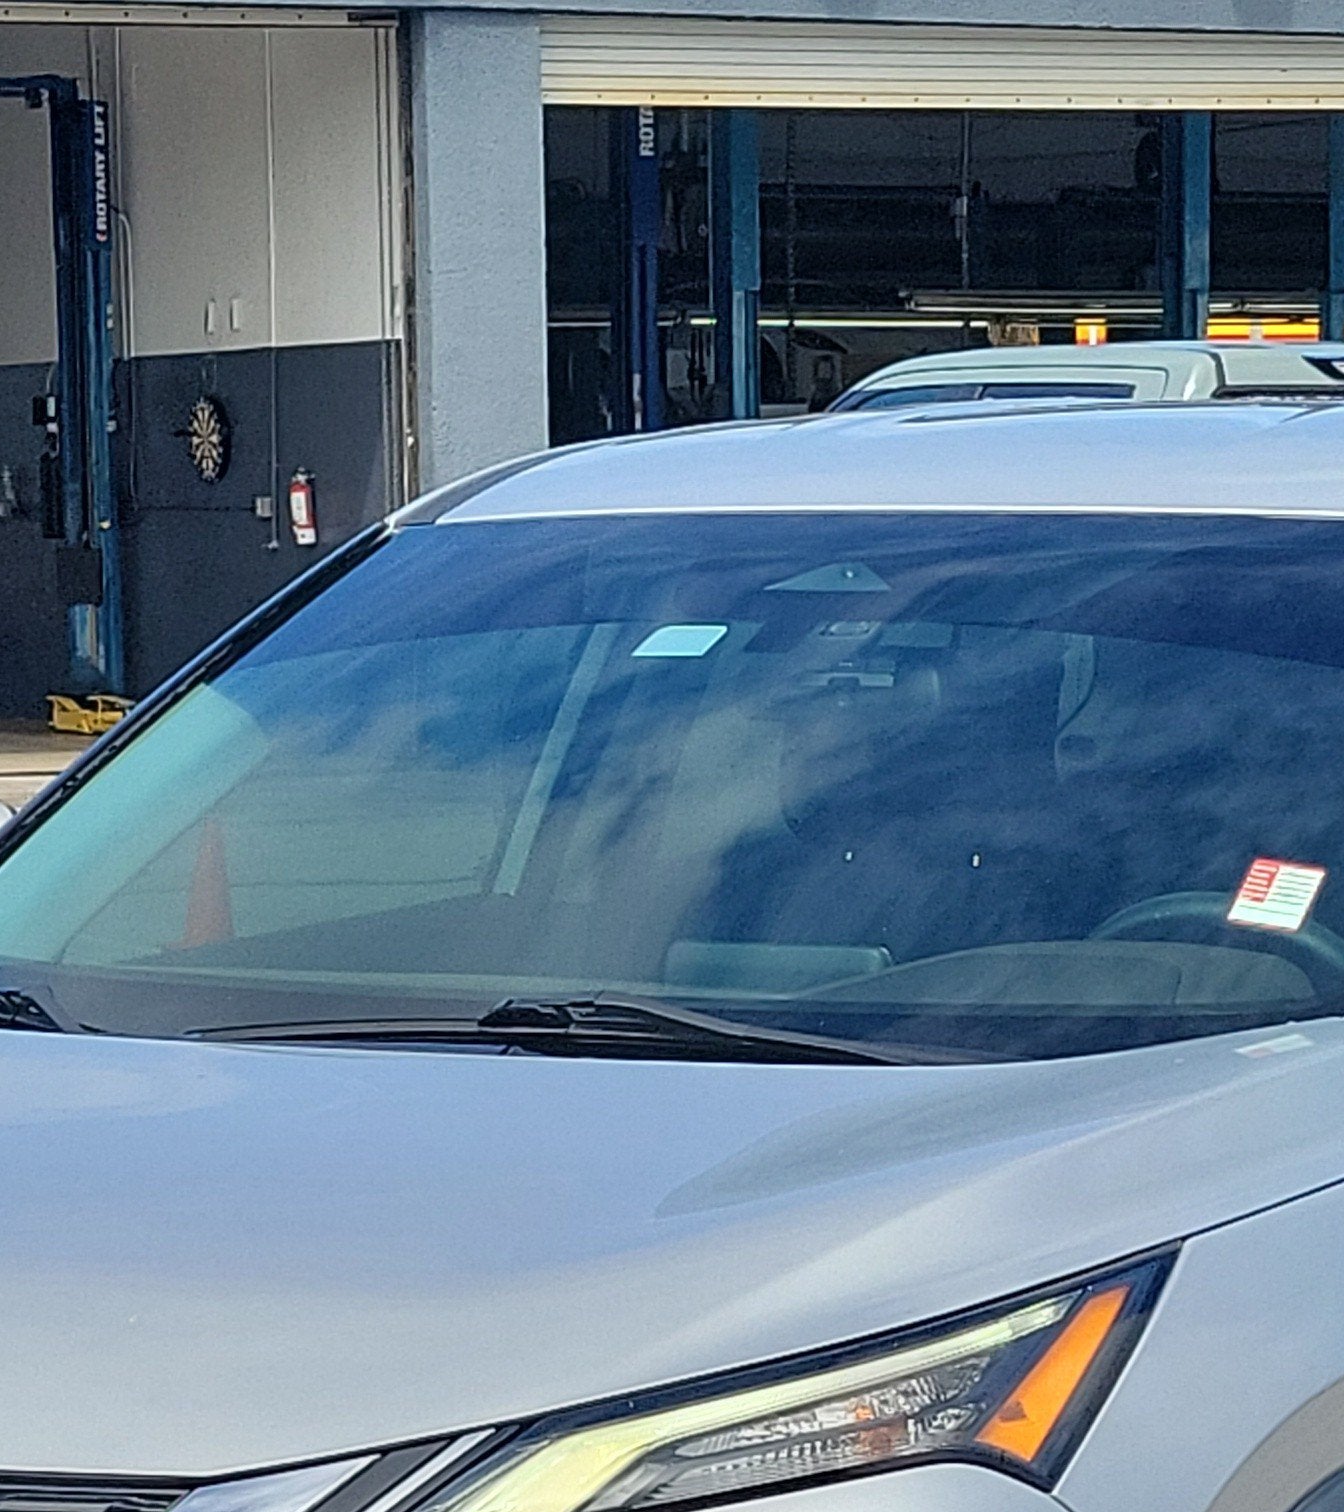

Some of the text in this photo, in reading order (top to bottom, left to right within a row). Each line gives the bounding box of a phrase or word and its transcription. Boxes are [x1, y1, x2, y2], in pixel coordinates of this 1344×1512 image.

[94, 104, 107, 230] ROTARY LIFT
[639, 106, 655, 156] ROTA
